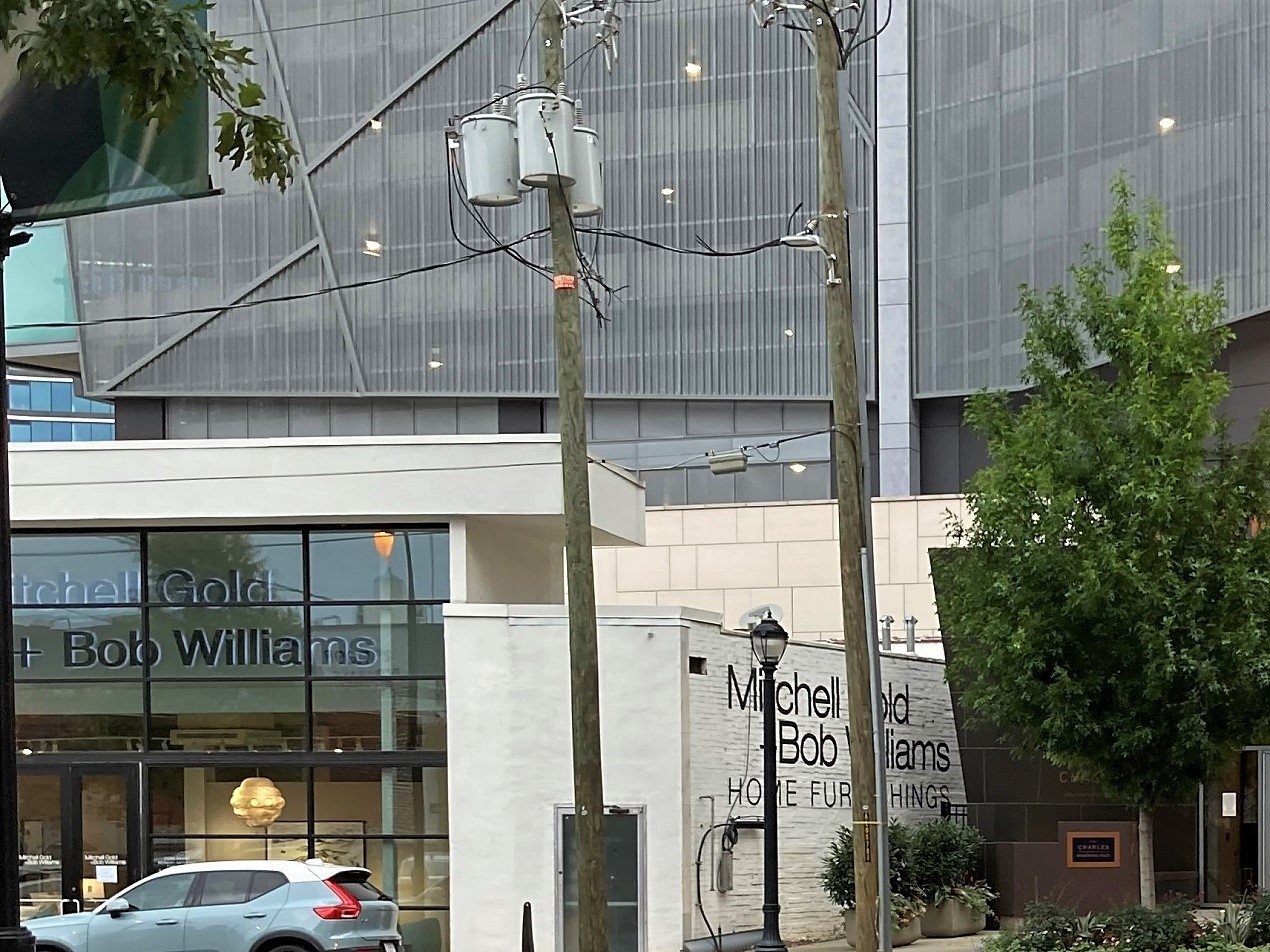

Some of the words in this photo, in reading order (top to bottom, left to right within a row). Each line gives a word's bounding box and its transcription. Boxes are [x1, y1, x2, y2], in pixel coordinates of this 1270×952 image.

[155, 568, 274, 609] Gold
[63, 629, 162, 669] Bob
[173, 627, 378, 669] Williams
[727, 664, 840, 719] Michell
